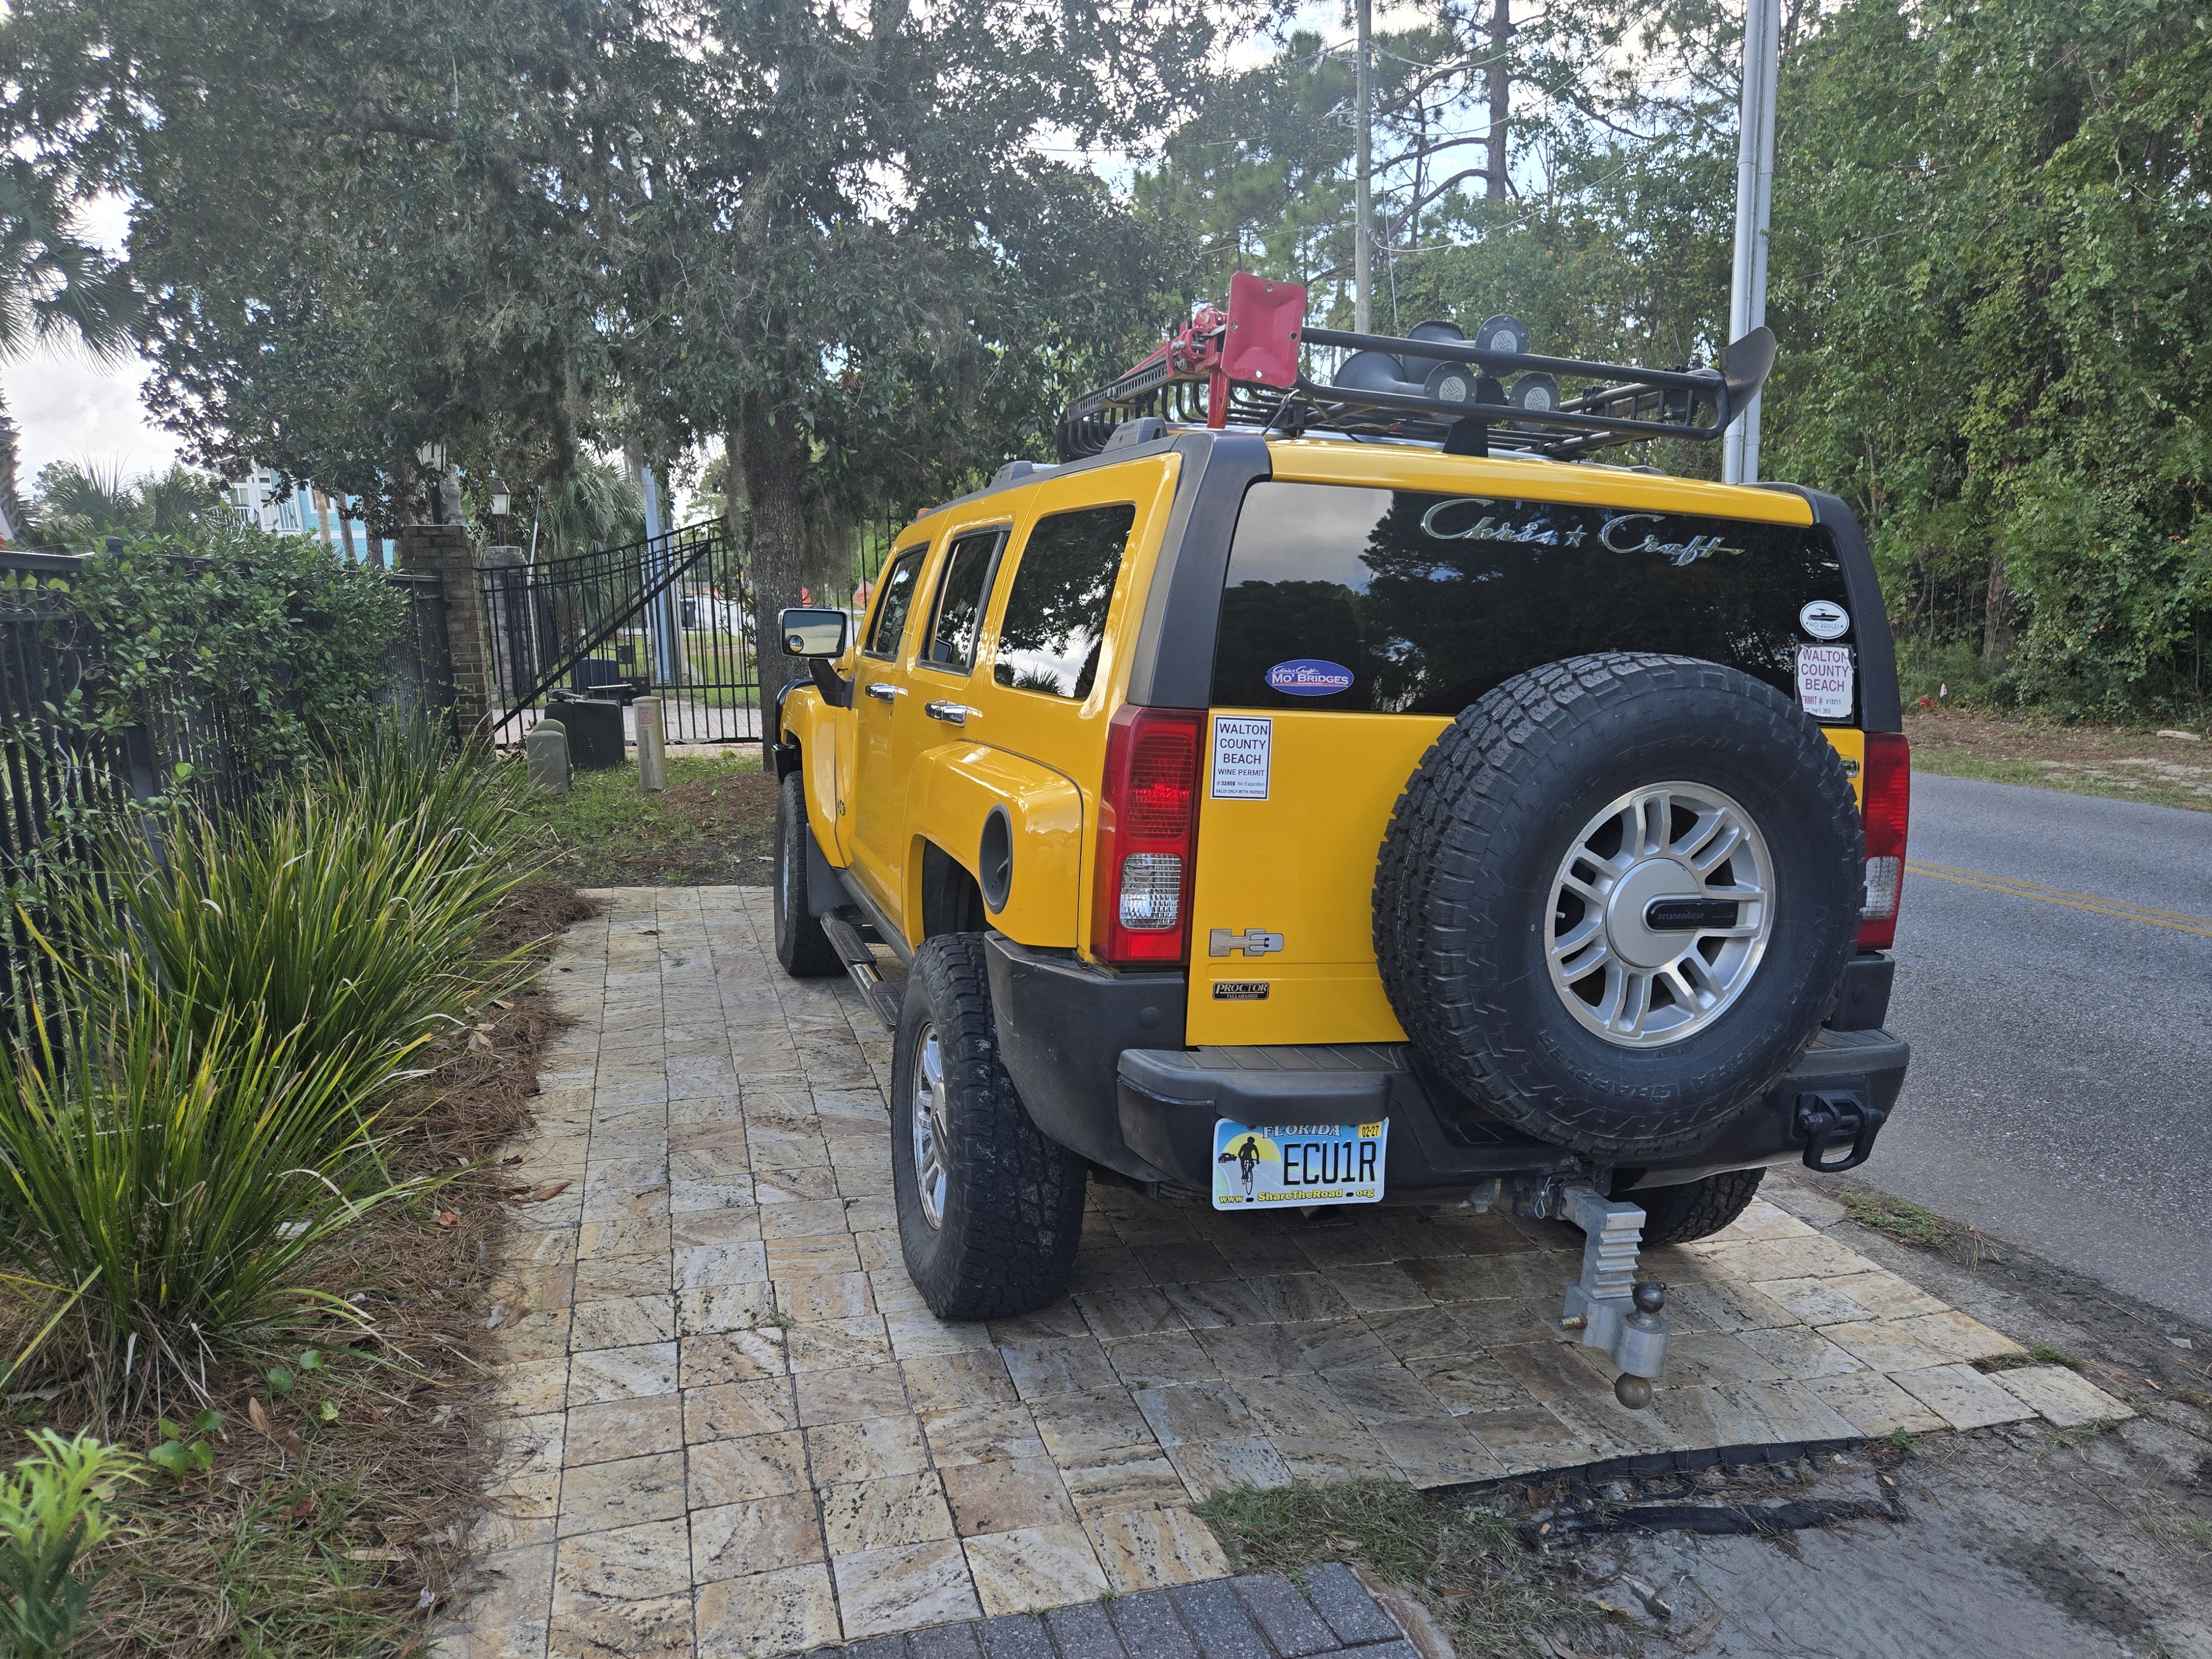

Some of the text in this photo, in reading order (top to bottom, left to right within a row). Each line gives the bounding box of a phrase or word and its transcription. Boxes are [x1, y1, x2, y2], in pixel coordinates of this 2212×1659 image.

[1420, 498, 1746, 567] Chris Craft
[1803, 649, 1847, 663] WALTON
[1801, 663, 1849, 677] COUNTY
[1272, 674, 1349, 685] MO' BRIDGES
[1805, 679, 1844, 692] BEACH
[1803, 695, 1817, 705] RMIT
[1219, 723, 1268, 735] WALTON
[1219, 738, 1266, 750] COUNTY
[1223, 753, 1261, 764] BEACH
[1209, 928, 1284, 957] H3
[1215, 984, 1267, 994] PROCTOR
[1262, 1124, 1341, 1139] FLORIDA
[1283, 1140, 1376, 1186] ECU1R
